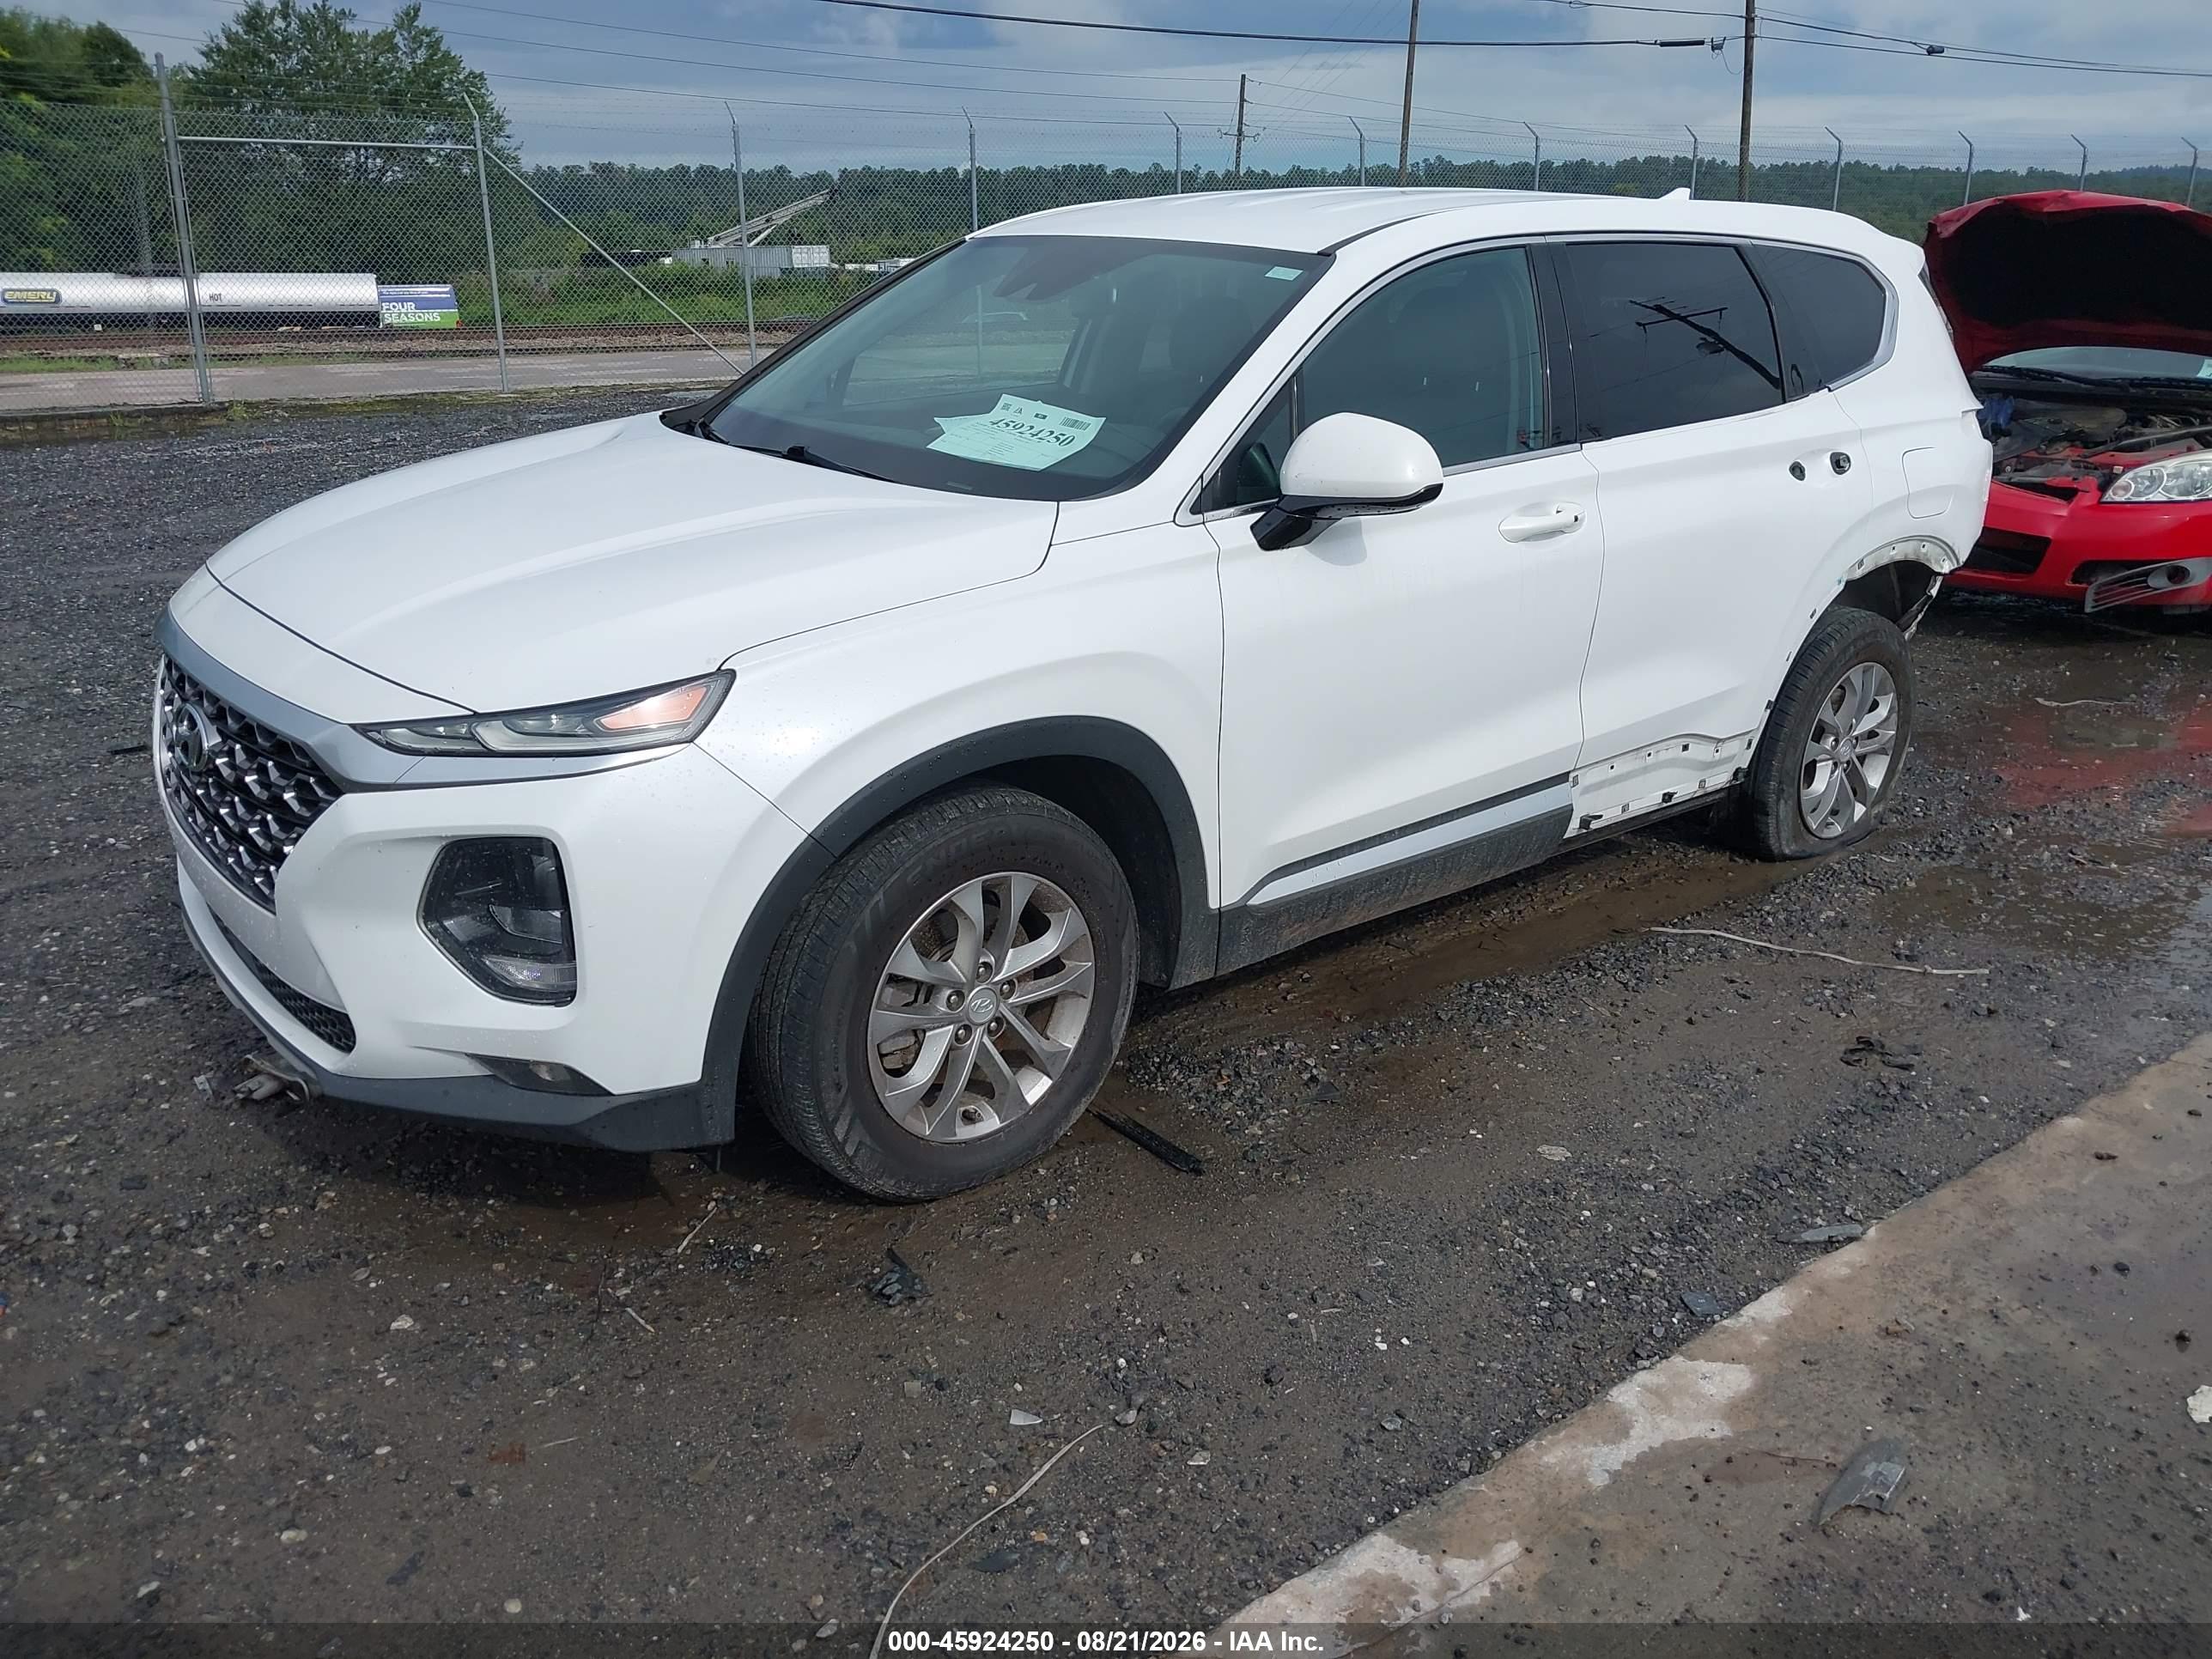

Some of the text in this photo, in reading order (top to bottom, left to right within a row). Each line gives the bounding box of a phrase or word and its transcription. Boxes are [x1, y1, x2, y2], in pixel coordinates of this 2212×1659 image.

[209, 292, 222, 303] HOT
[381, 301, 416, 311] FOUR
[383, 312, 441, 323] SEASONS
[988, 417, 1076, 447] 45924250
